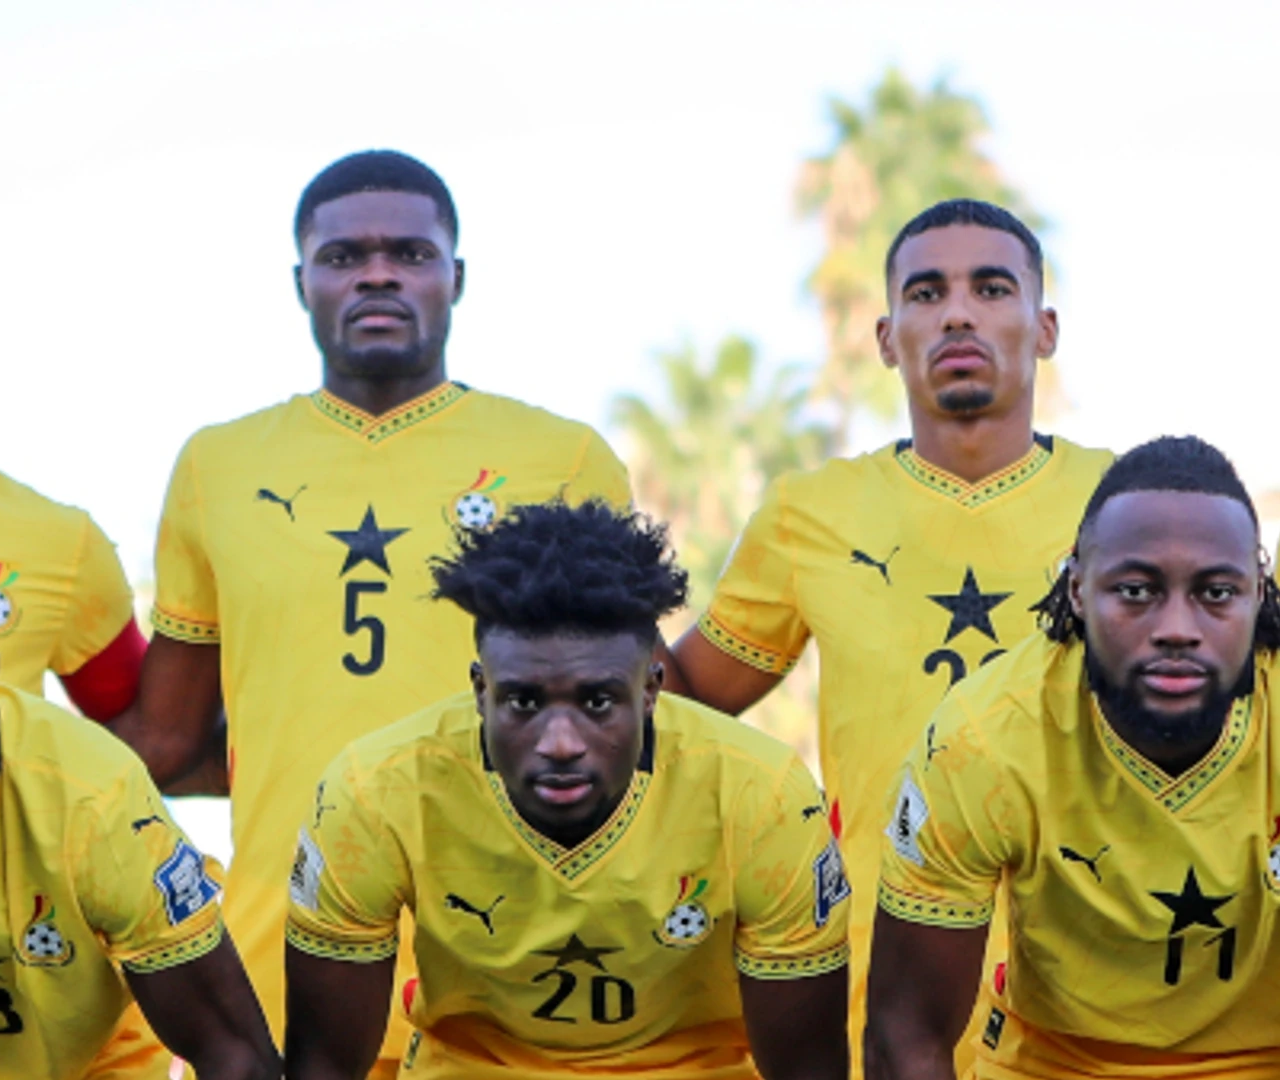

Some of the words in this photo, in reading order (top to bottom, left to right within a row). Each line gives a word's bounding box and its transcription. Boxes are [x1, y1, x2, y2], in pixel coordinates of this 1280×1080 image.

[342, 581, 388, 676] 5
[1163, 924, 1237, 987] 11
[531, 967, 635, 1026] 20
